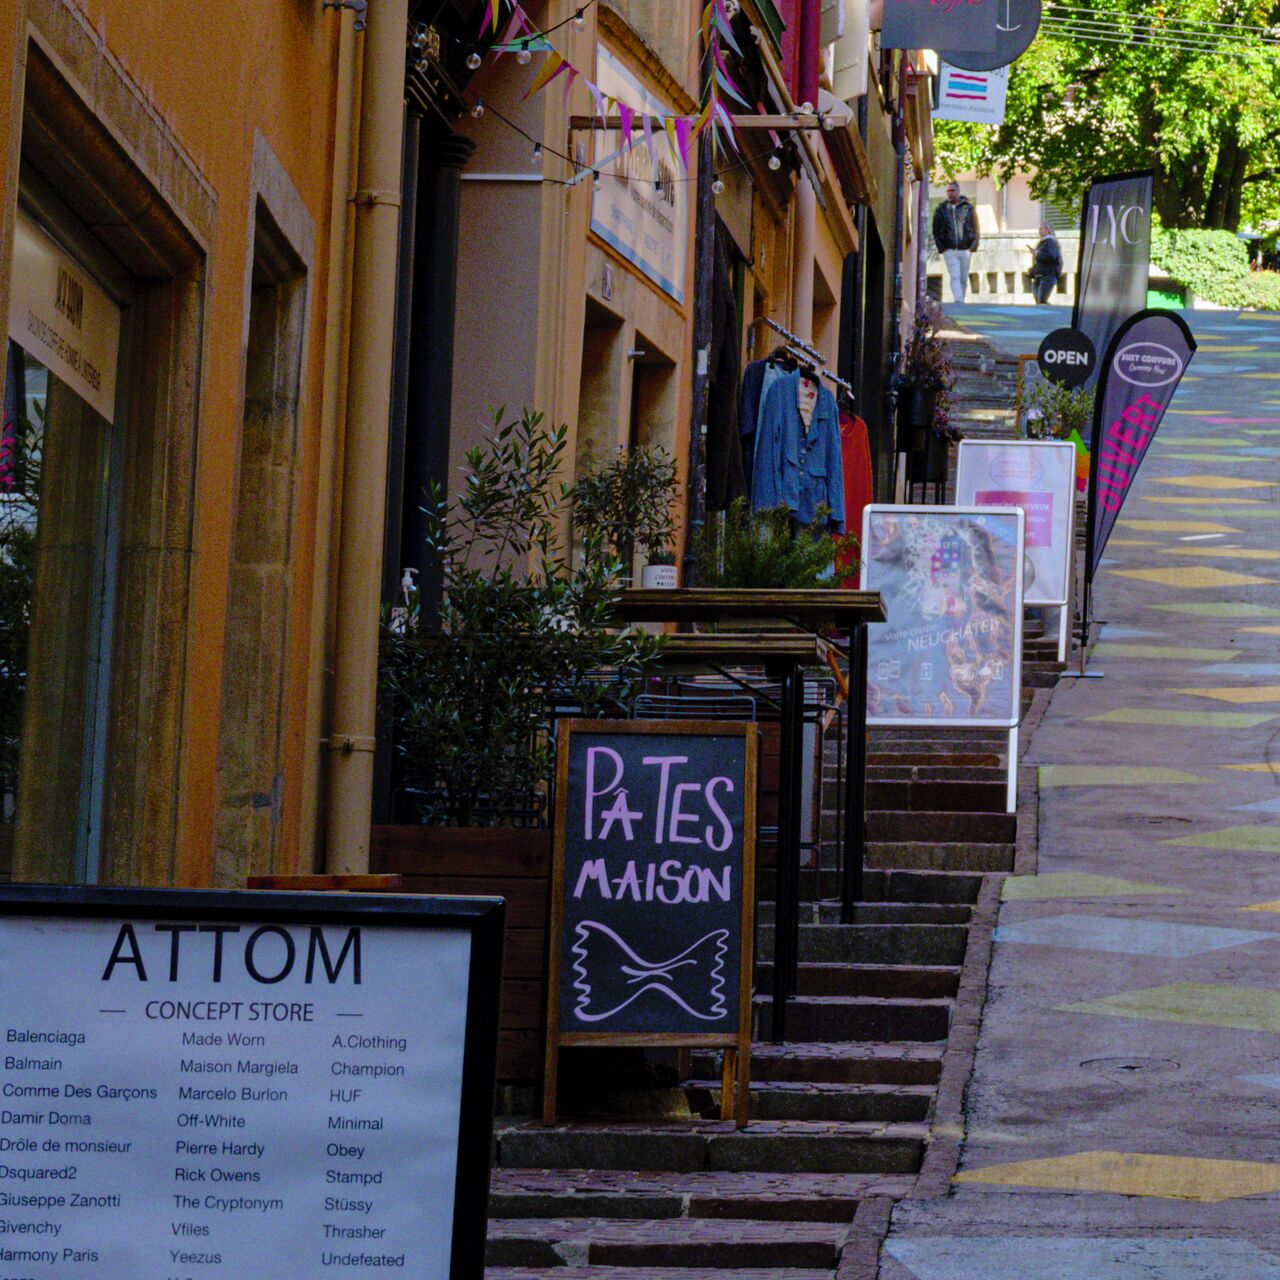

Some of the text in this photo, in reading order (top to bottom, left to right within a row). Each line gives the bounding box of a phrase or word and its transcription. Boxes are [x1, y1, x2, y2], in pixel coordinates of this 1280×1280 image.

[1044, 349, 1088, 366] OPEN
[1098, 393, 1162, 512] OUVERT
[585, 746, 734, 851] PÂTES
[574, 858, 731, 904] MAISON
[101, 923, 362, 985] ATTOM
[146, 1001, 314, 1022] CONCEPT STORE
[7, 1029, 86, 1046] Balenciaga
[182, 1032, 265, 1047] Made Worn
[332, 1035, 407, 1052] A.Clothing
[5, 1056, 62, 1071] Balmain
[180, 1060, 299, 1077] Maison Margiela
[331, 1062, 405, 1078] Champion
[3, 1083, 158, 1101] Comme Des Garçons
[179, 1087, 288, 1102] Marcelo Burlon
[329, 1090, 362, 1103] HUF
[1, 1111, 91, 1126] Damir Doma
[177, 1114, 246, 1129] Off-White
[328, 1117, 384, 1131] Minimal
[0, 1139, 132, 1153] Drôle de monsieur
[176, 1141, 265, 1159] Pierre Hardy
[326, 1143, 366, 1160] Obey
[0, 1166, 77, 1182] Dsquared2
[174, 1168, 261, 1182] Rick Owens
[326, 1170, 383, 1187] Stampd
[0, 1193, 121, 1209] Giuseppe Zanotti
[173, 1195, 284, 1213] The Cryptonym
[324, 1197, 373, 1215] Stüssy
[171, 1223, 210, 1236] Vfiles
[323, 1224, 386, 1239] Thrasher
[62, 1248, 99, 1263] Paris
[169, 1250, 222, 1264] Yeezus
[321, 1252, 405, 1267] Undefeated
